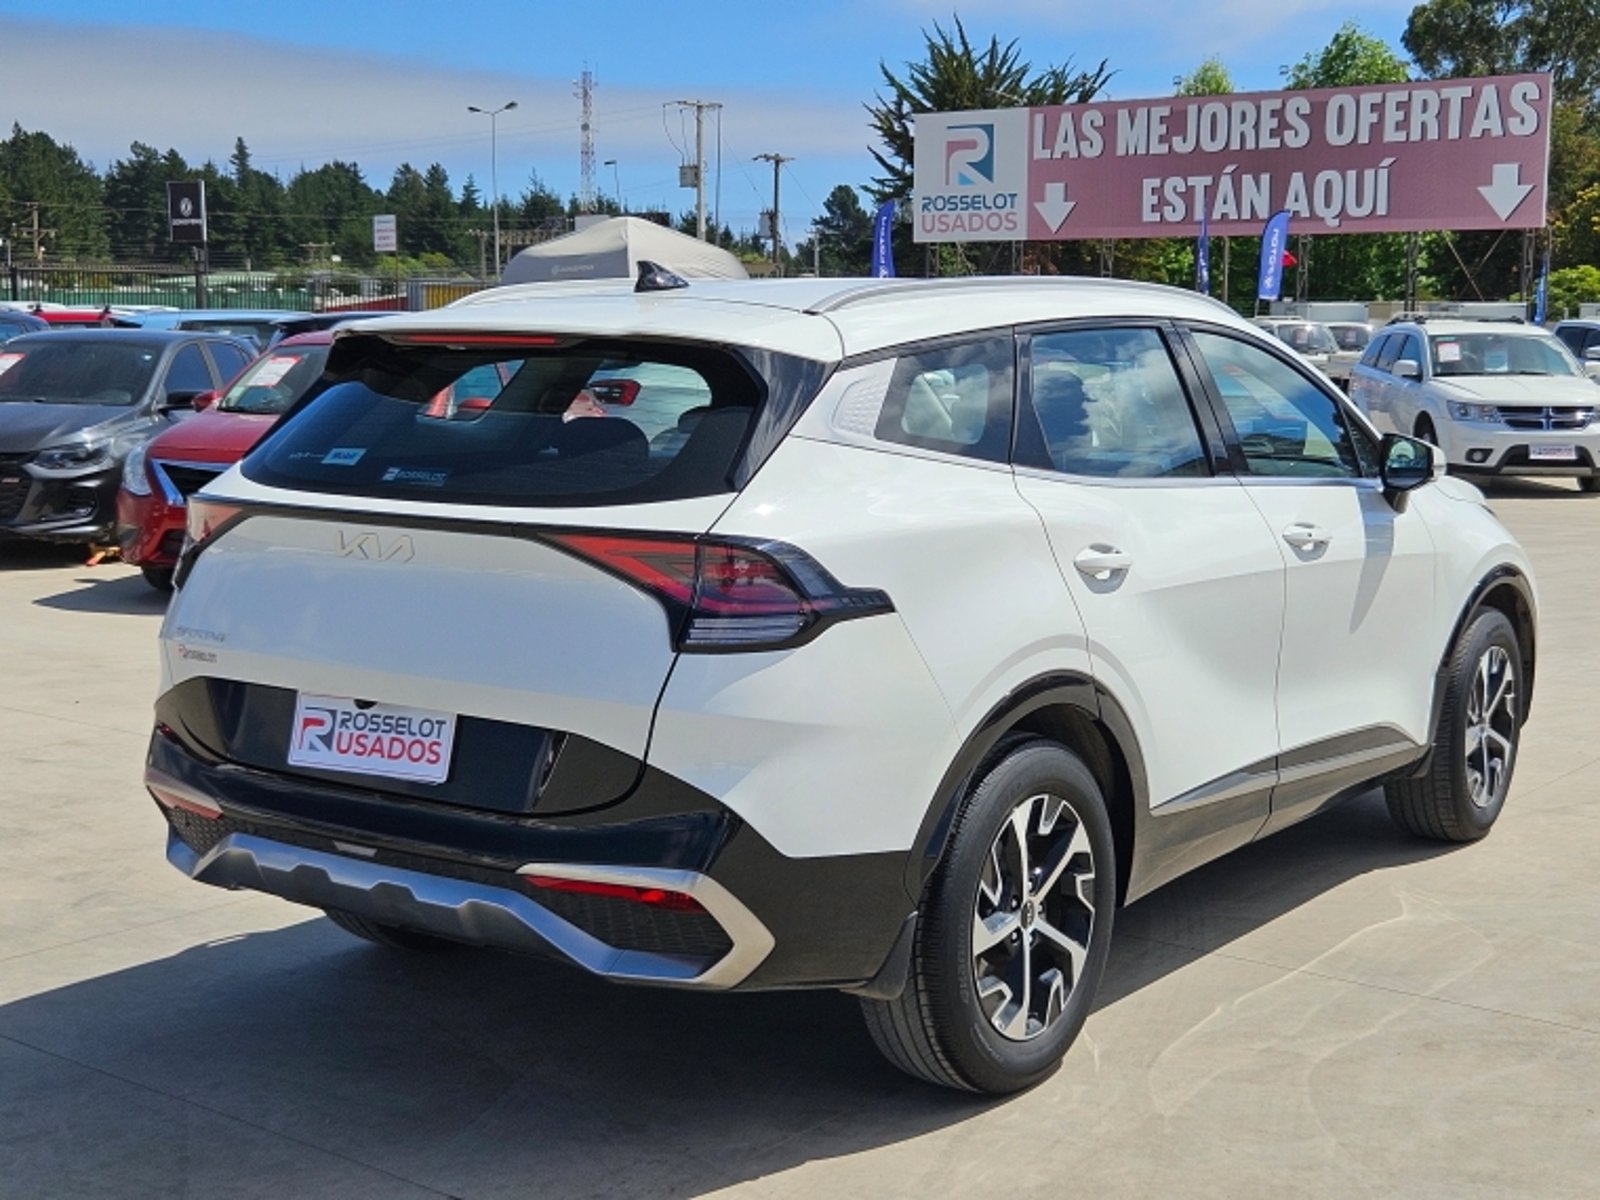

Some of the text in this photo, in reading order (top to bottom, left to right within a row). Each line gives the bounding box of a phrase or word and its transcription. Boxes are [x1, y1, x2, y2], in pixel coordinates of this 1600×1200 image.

[1033, 81, 1540, 160] LAS MEJORES OFERTAS
[921, 193, 1017, 212] ROSSELOT
[1142, 157, 1397, 227] ESTÁN AQUÍ
[921, 212, 1017, 233] USADOS
[336, 530, 415, 562] KIA
[338, 711, 446, 739] ROSSELOT
[336, 732, 442, 765] USADOS
